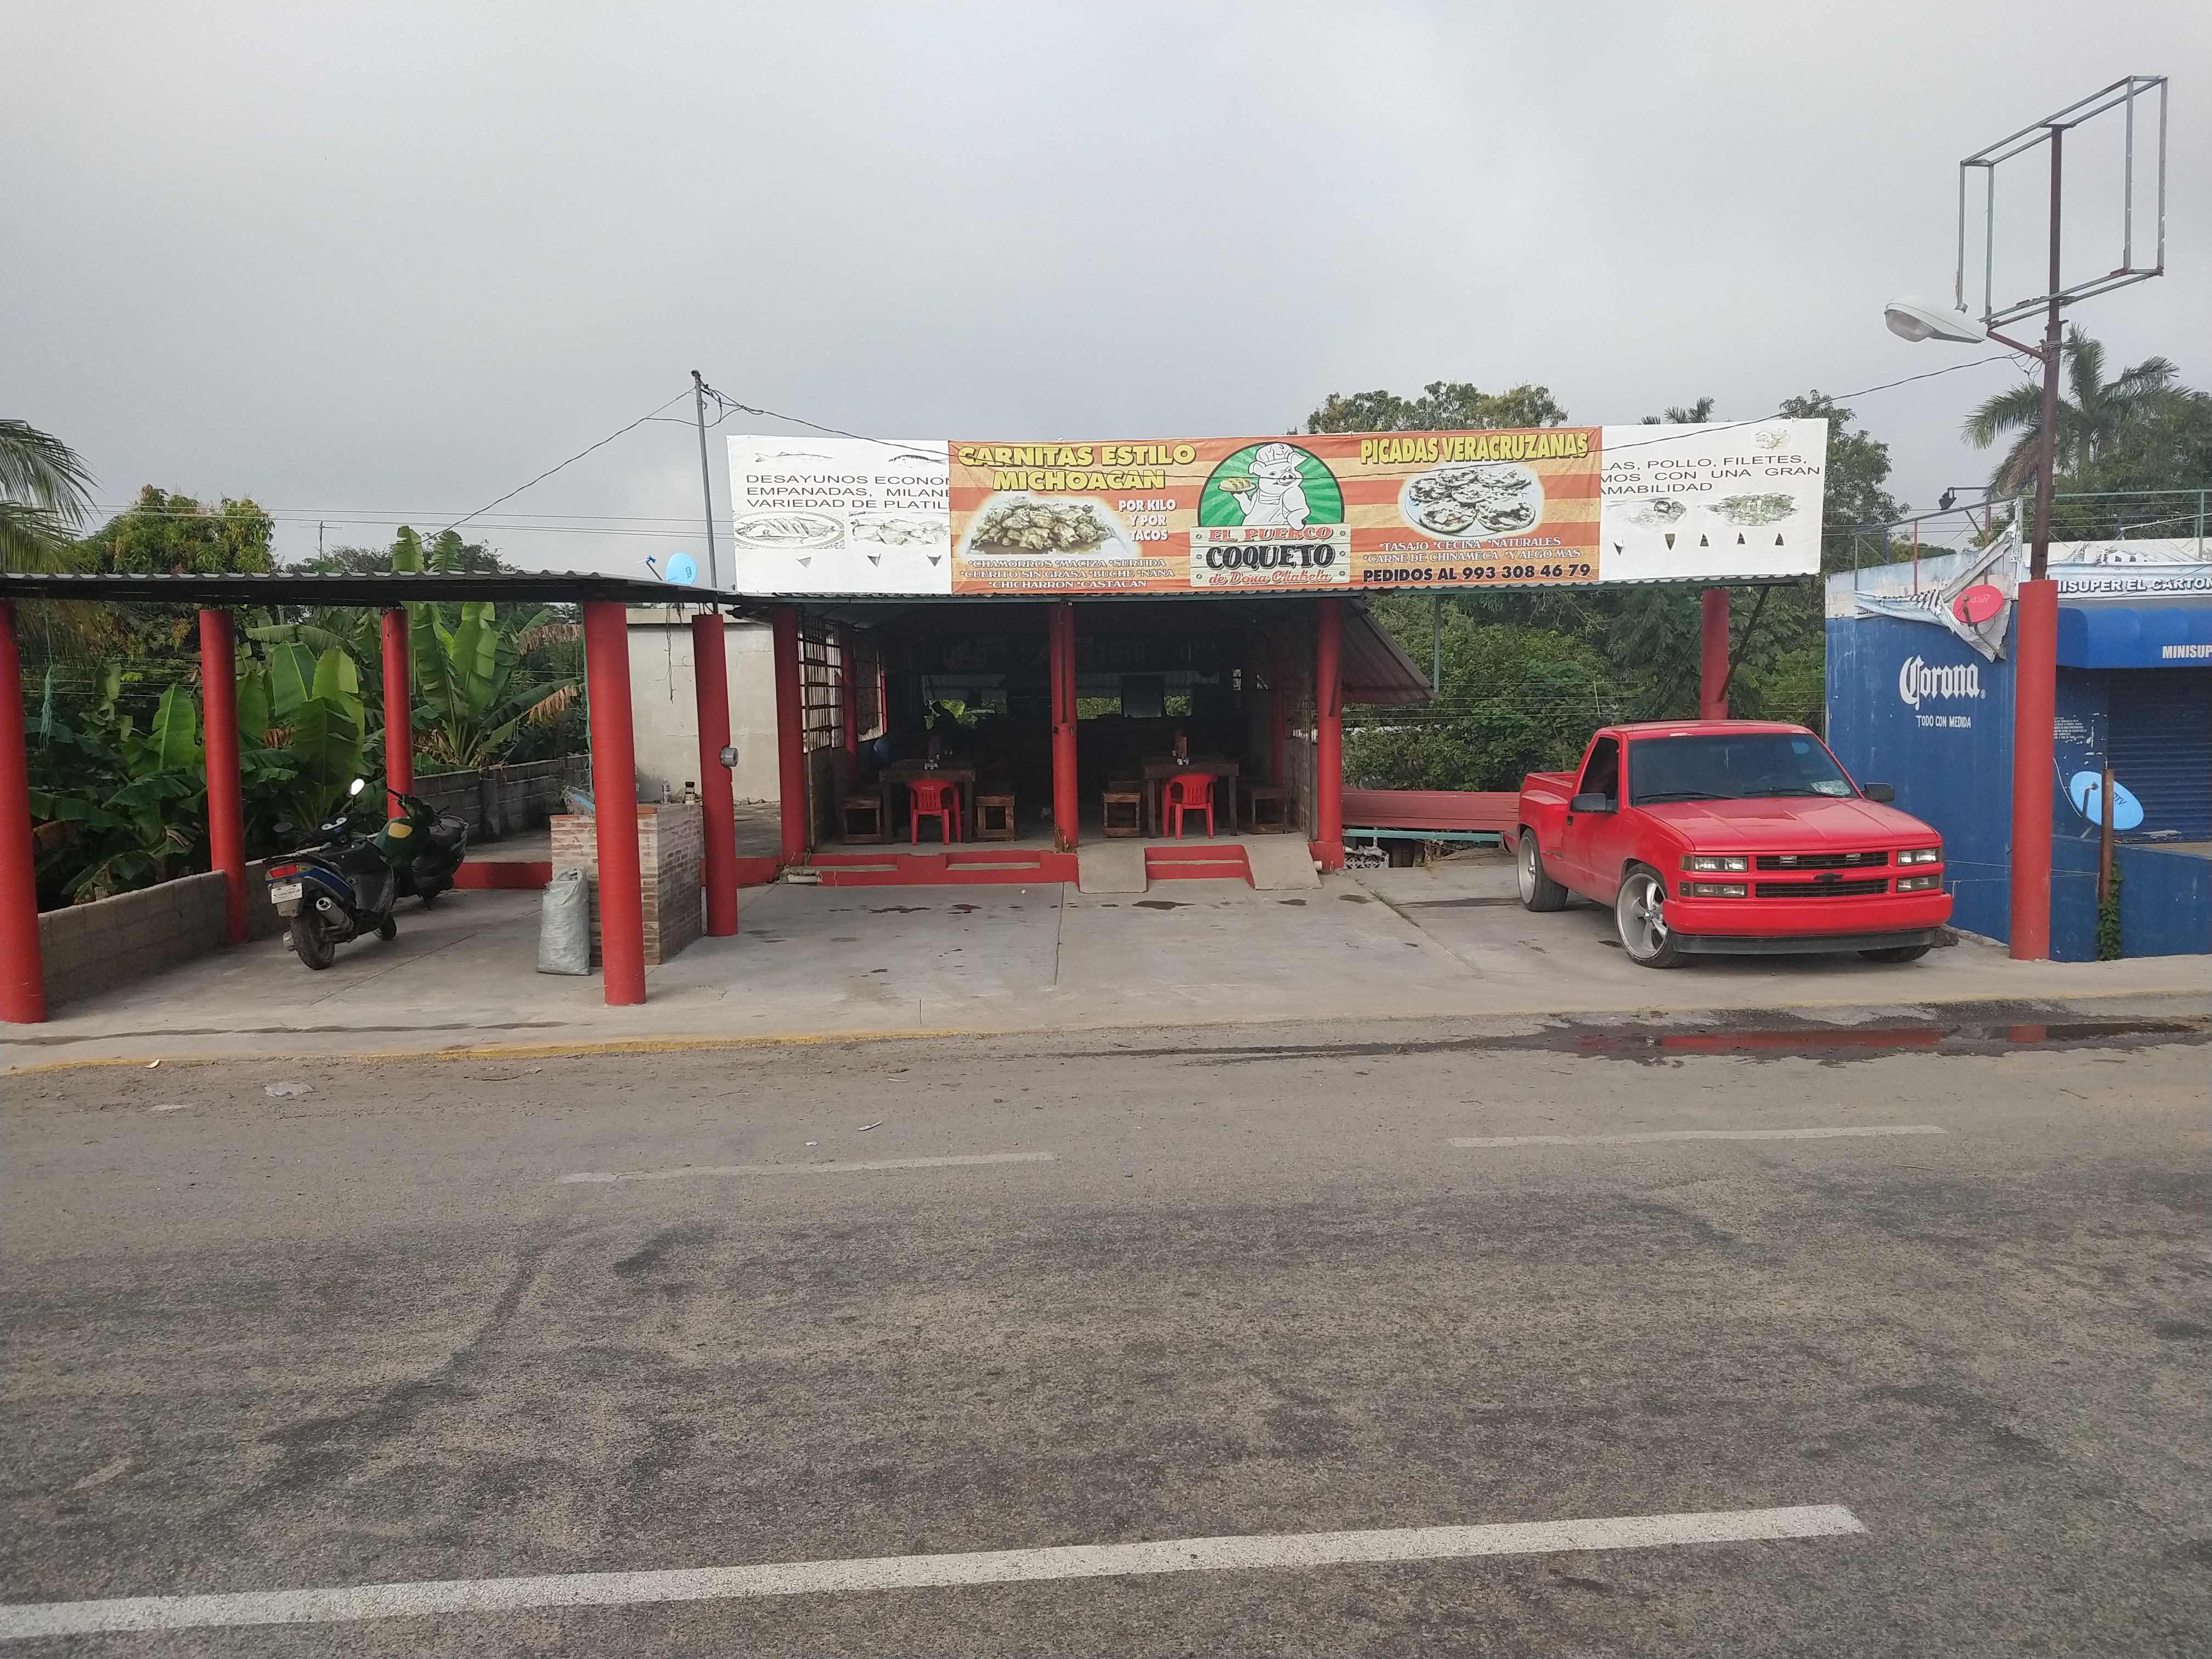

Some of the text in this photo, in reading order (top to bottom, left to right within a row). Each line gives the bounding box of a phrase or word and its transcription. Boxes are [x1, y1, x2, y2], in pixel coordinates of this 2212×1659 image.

[1361, 432, 1588, 464] PICADAS VERACRUZANAS
[957, 444, 1196, 467] CARNITAS ESTILO
[1647, 458, 1717, 469] POLLO,
[1724, 455, 1807, 466] FILETES,
[746, 475, 868, 484] DESAYUNOS
[992, 468, 1165, 492] MICHOACAN
[1655, 471, 1696, 481] CON
[1711, 469, 1752, 478] UNA
[1765, 467, 1820, 476] GRAN
[747, 487, 872, 497] EMPANADAS,
[746, 499, 950, 509] VARIEDAD DE PLATIL
[1119, 499, 1177, 512] POR KILO
[1130, 514, 1167, 527] Y POR
[1130, 529, 1169, 541] TACOS
[1208, 527, 1333, 542] EL PUERCO
[1206, 543, 1335, 570] COQUETO
[1410, 553, 1426, 562] DE
[1429, 551, 1499, 562] CHINAMECA
[1519, 550, 1553, 559] ALGO
[1555, 549, 1581, 558] MAS
[1209, 574, 1227, 585] de
[1272, 569, 1333, 584] Chabela
[1363, 563, 1591, 583] PEDIDOS AL 993 308 46 79
[2126, 579, 2146, 591] EL
[1970, 594, 1990, 603] dish
[2162, 645, 2212, 659] MINISUP
[1899, 654, 1980, 711] Corona
[1916, 715, 1971, 729] TODO CON MEDIDA
